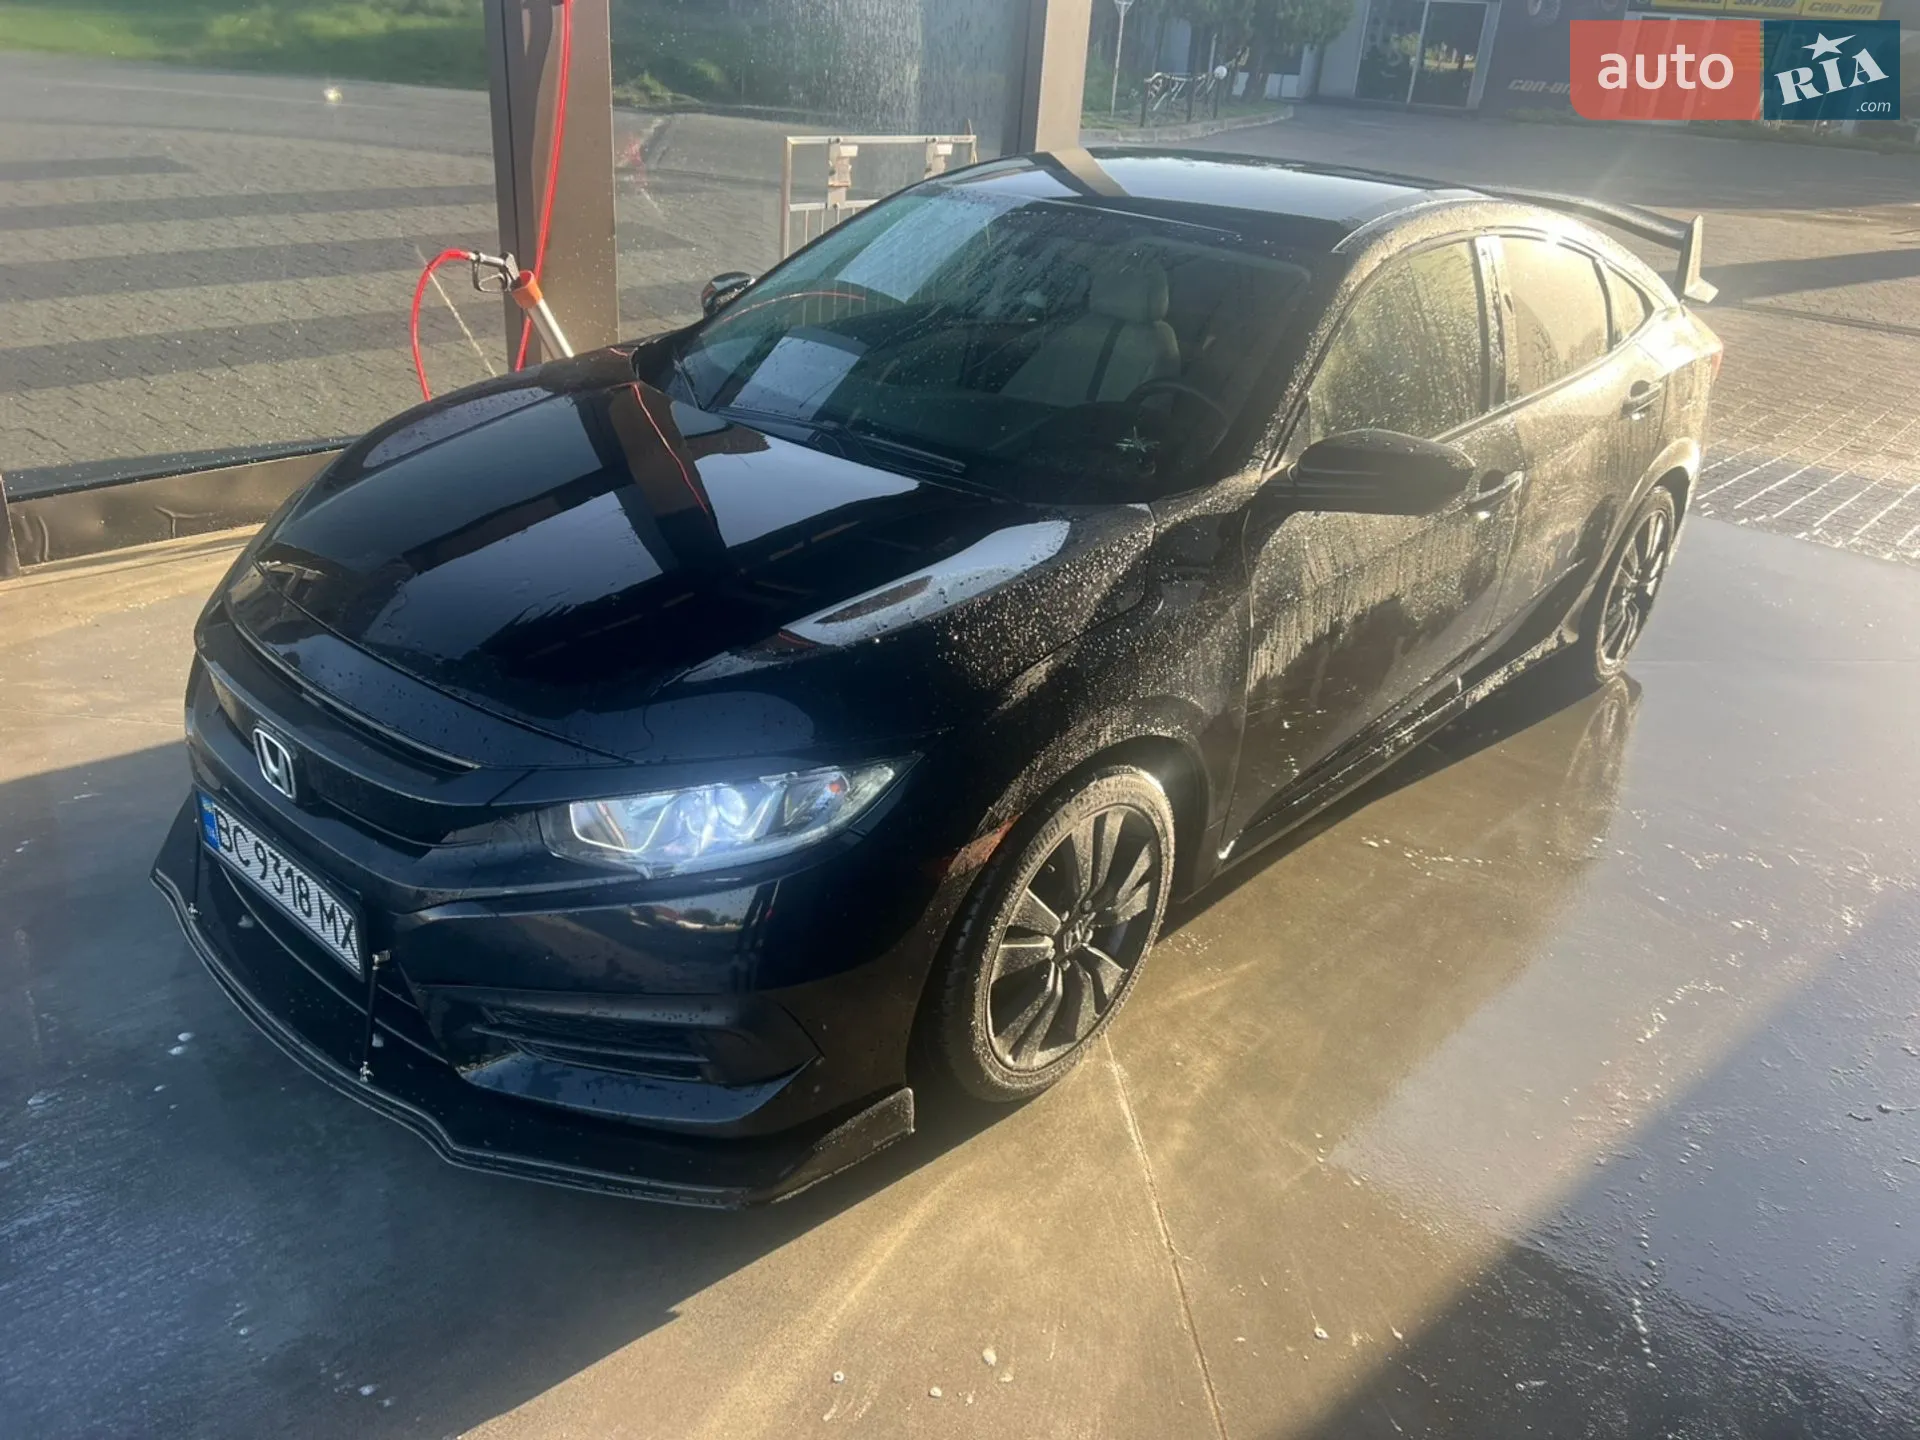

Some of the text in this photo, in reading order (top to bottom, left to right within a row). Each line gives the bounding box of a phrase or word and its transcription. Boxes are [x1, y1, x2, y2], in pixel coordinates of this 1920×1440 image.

[214, 807, 359, 960] BC 9318 MX
